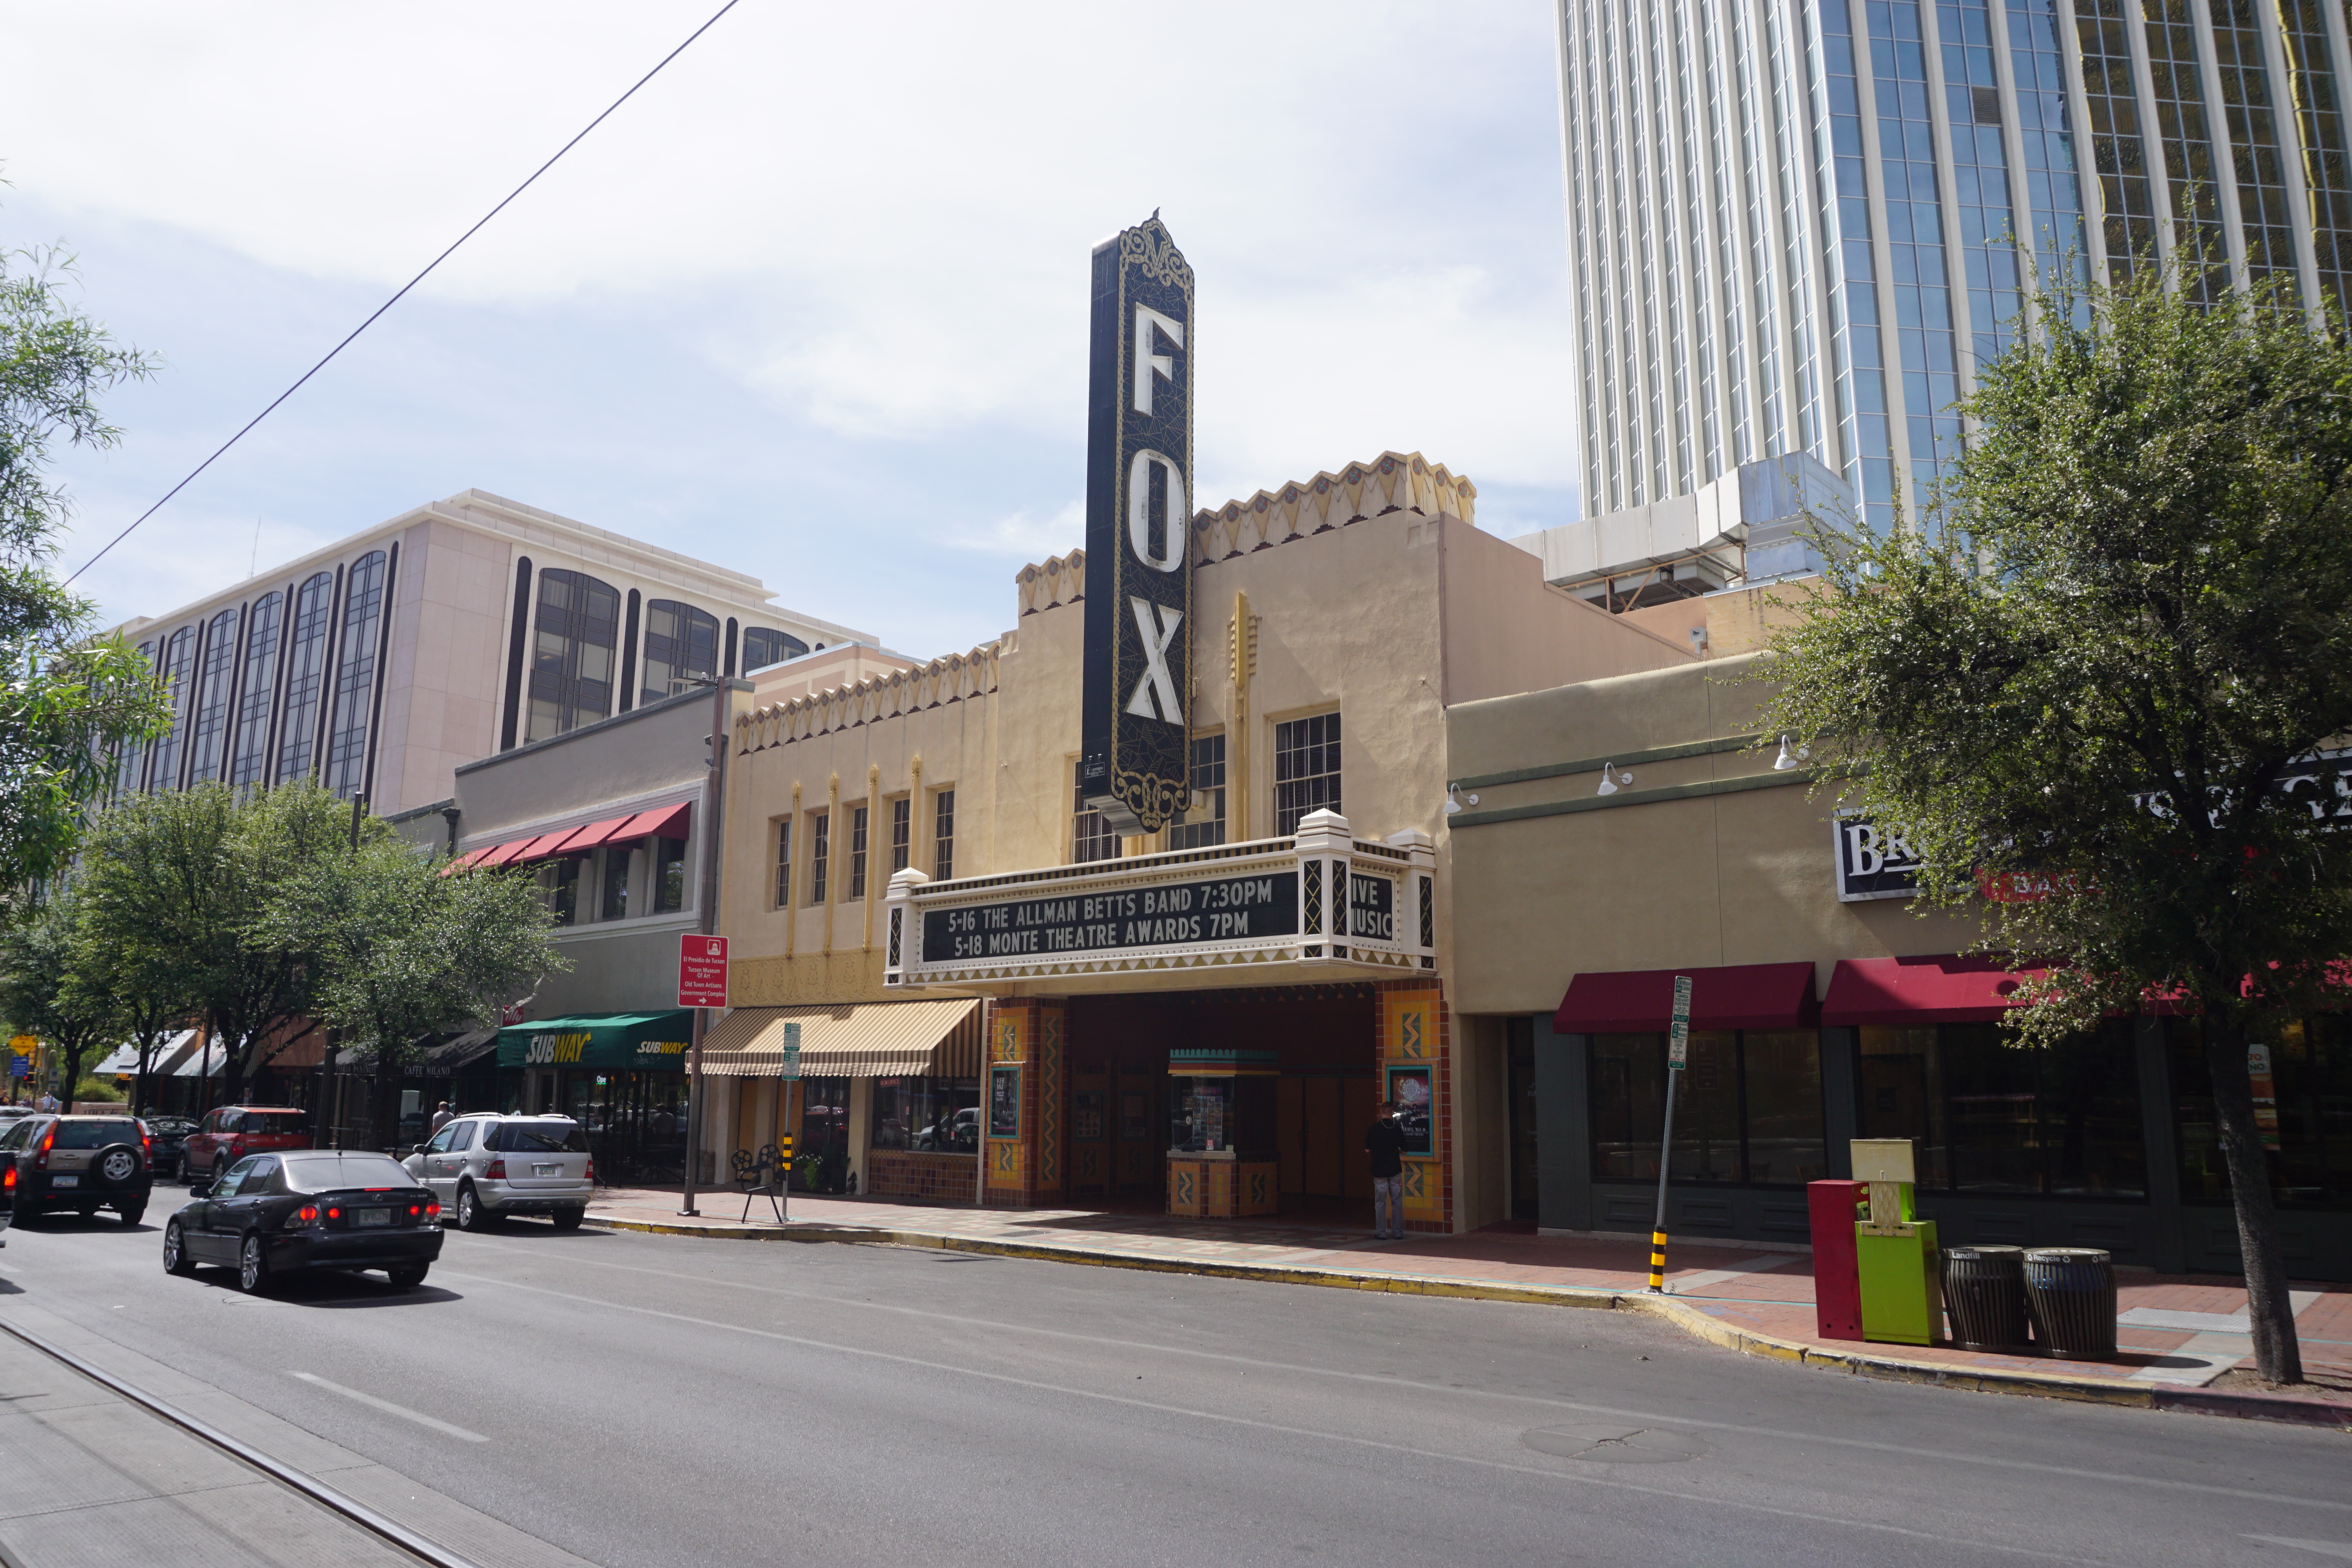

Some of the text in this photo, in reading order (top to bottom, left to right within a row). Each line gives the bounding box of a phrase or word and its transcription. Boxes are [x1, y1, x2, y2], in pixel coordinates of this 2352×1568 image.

[1125, 301, 1185, 726] FOX
[1351, 877, 1378, 905] IVE
[949, 879, 1272, 933] 5-16 THE ALLMAN BETTS BAND 7:30PM
[955, 911, 1249, 956] 5-18 MONTE THEATRE AWARDS 7PM
[526, 1032, 591, 1063] SUBWAY
[637, 1041, 688, 1054] SUBWAY
[336, 1065, 377, 1074] TORIA PANINOT
[427, 1067, 450, 1075] MILANO
[597, 1075, 606, 1084] Ope
[1952, 1251, 1980, 1259] Landfill
[2033, 1254, 2060, 1263] Recycle
